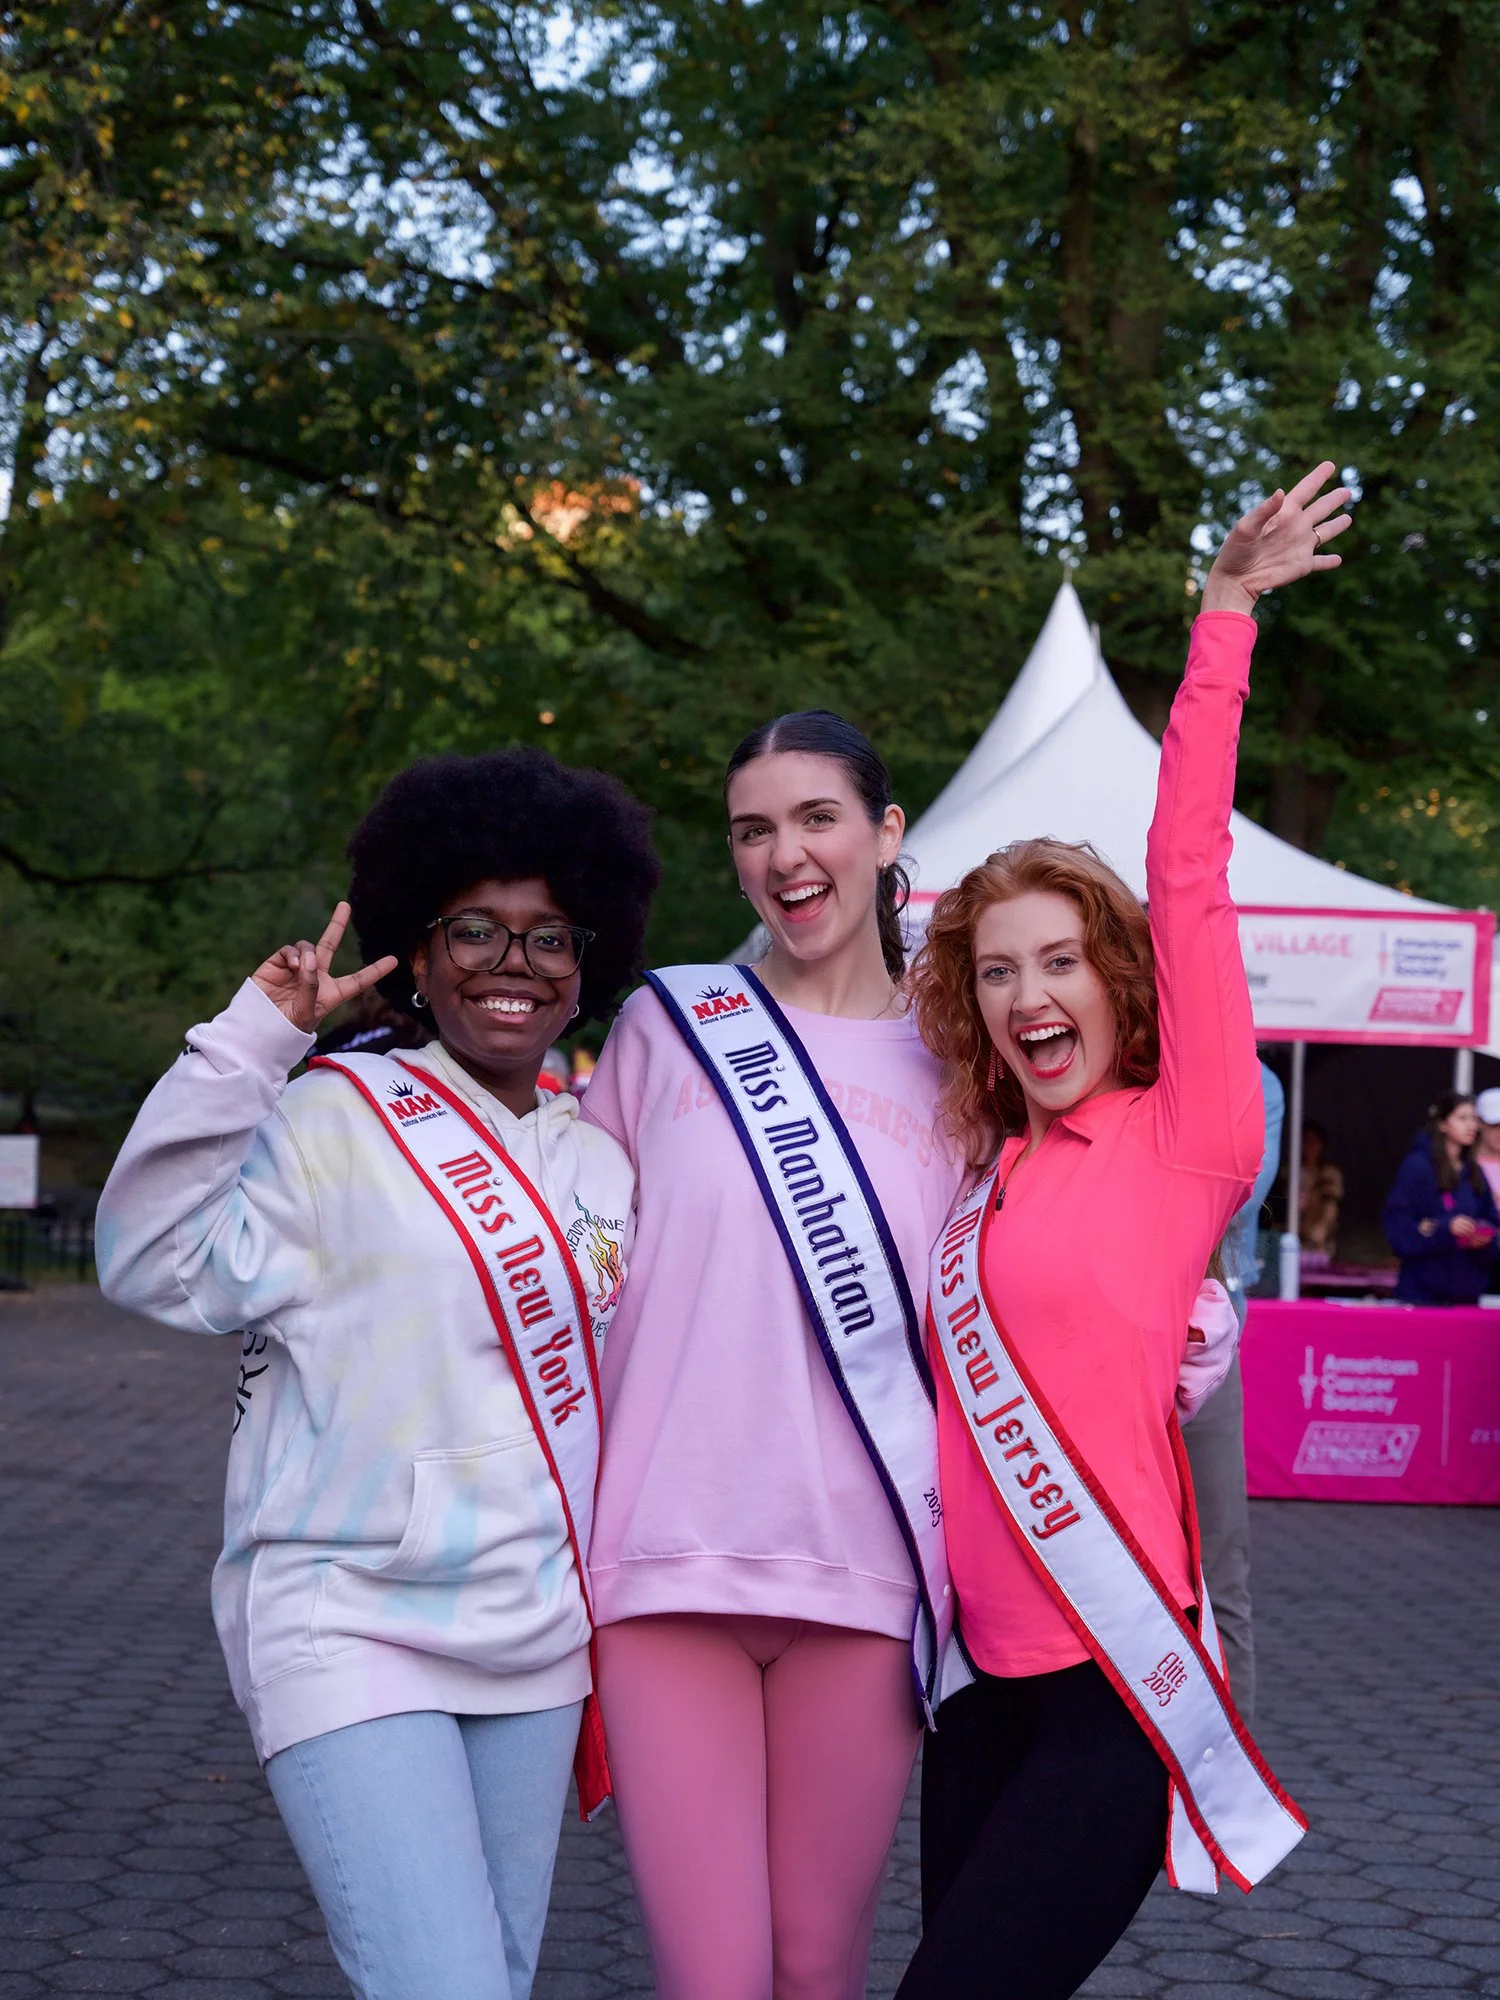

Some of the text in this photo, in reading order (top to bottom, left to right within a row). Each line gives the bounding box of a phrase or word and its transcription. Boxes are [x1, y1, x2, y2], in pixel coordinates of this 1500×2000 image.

[1251, 931, 1354, 958] VILLAGE
[691, 992, 750, 1020] NAM
[699, 1016, 719, 1026] National
[719, 1010, 742, 1020] American
[387, 1093, 441, 1120] NAM
[401, 1117, 419, 1128] National
[418, 1112, 438, 1123] American
[723, 1039, 876, 1336] Miss Manhattan
[437, 1149, 586, 1430] Miss New York
[940, 1204, 1082, 1541] Miss New Jersey
[923, 1487, 944, 1528] 2025
[1157, 1651, 1188, 1689] Elite
[1141, 1671, 1178, 1708] 2025
